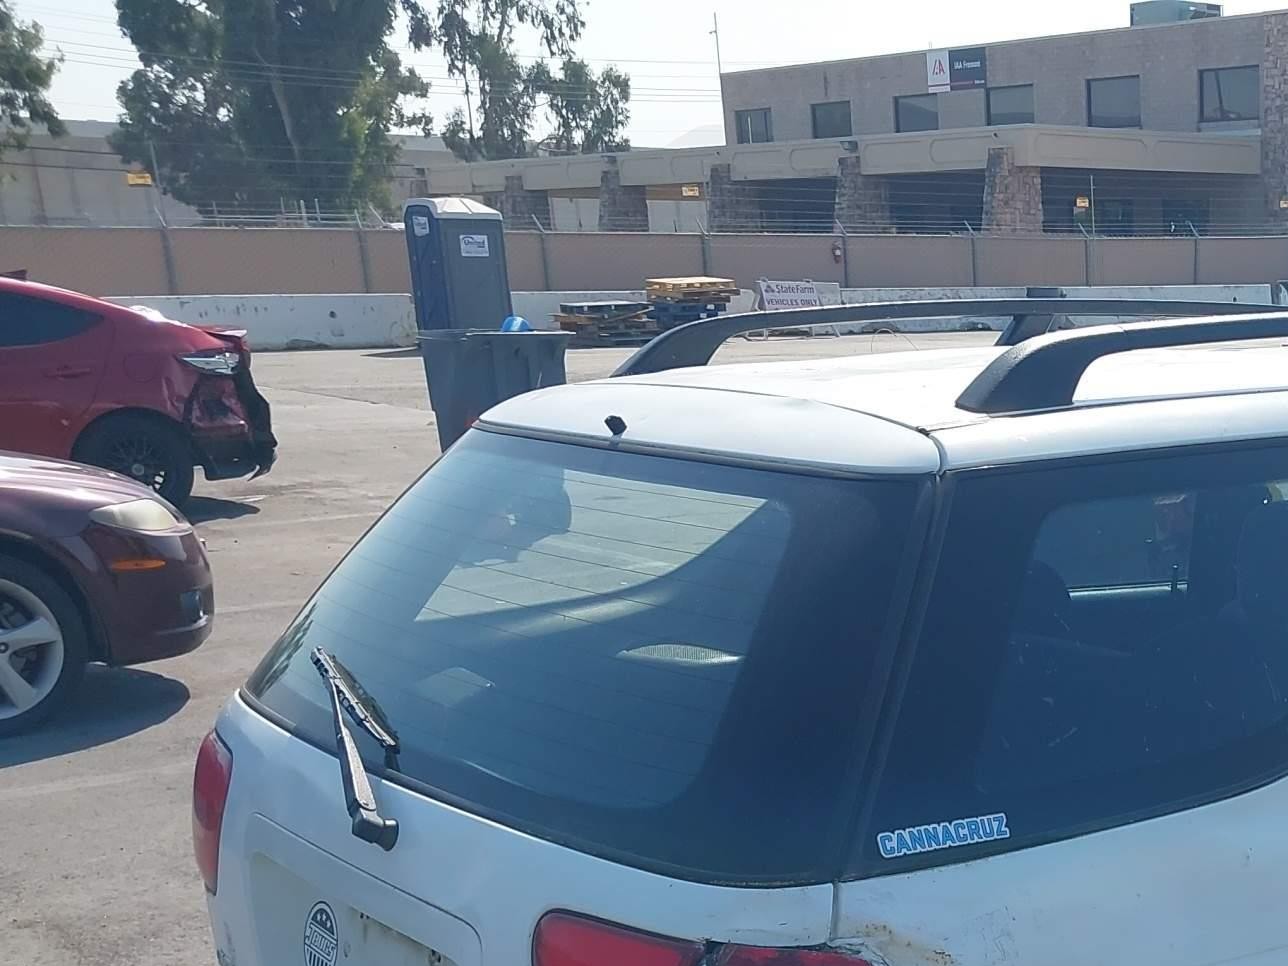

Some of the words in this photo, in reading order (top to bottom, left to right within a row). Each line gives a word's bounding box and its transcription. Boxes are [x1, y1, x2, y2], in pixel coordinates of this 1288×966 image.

[766, 298, 799, 306] VEHICLES
[800, 298, 818, 306] ONLY
[878, 814, 1009, 857] CANNACRUZ
